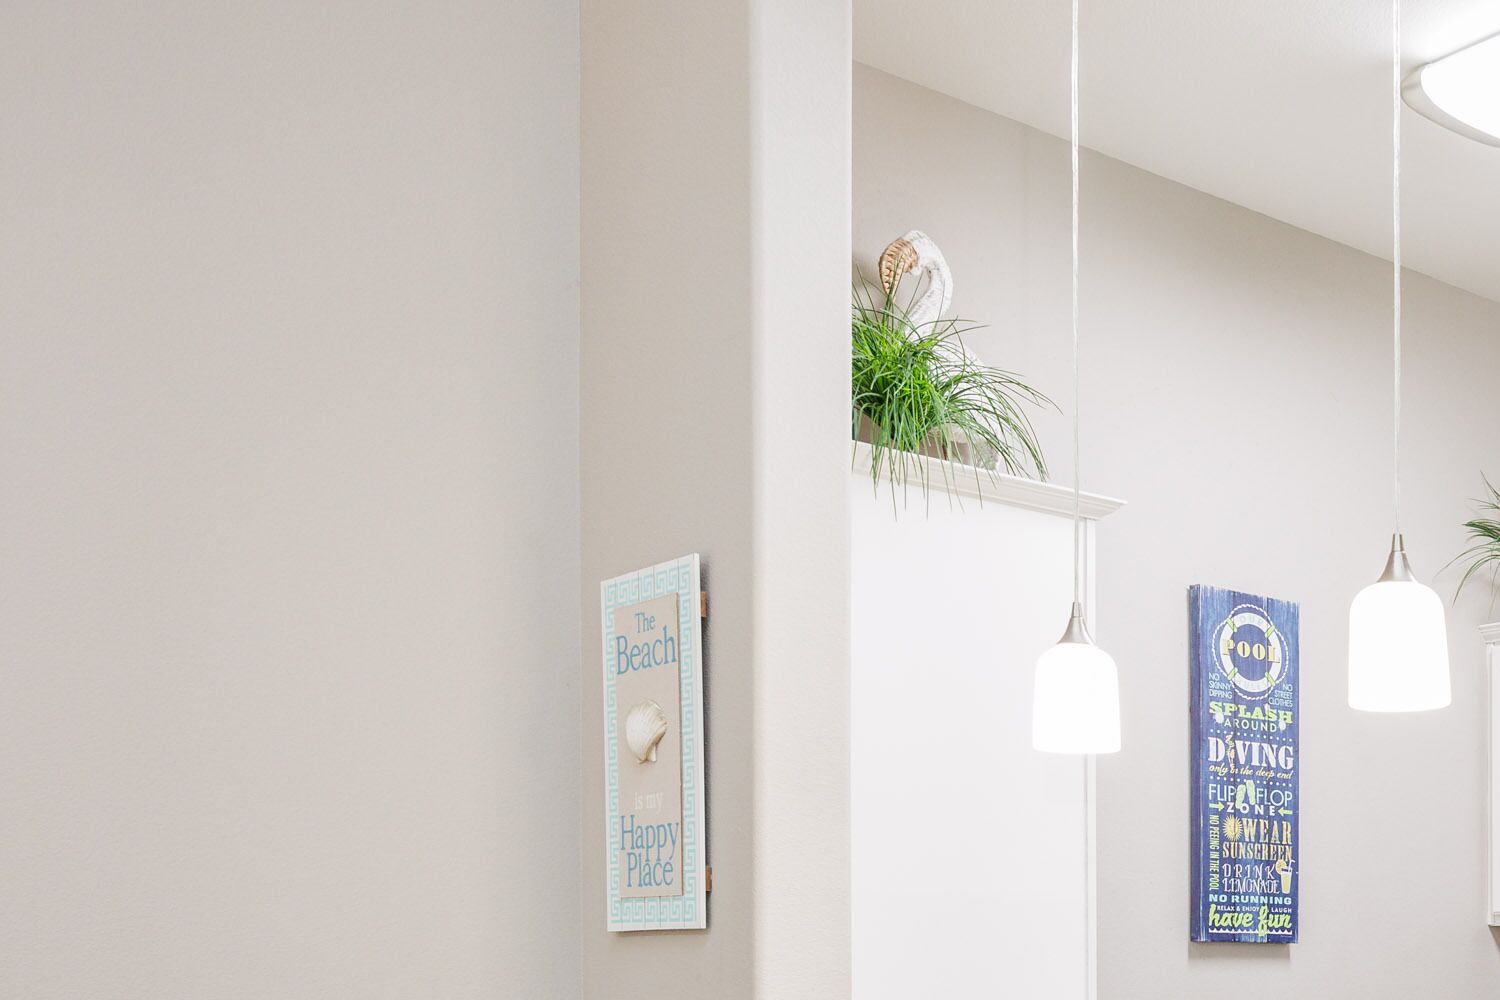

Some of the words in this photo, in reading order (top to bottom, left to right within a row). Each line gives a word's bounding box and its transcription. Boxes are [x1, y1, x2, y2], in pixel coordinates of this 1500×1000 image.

[634, 611, 656, 633] The
[616, 624, 677, 675] Beach
[1221, 638, 1281, 664] POOL
[1208, 672, 1220, 681] NO
[1208, 681, 1232, 690] SKINNY
[1282, 684, 1293, 692] NO
[1208, 701, 1294, 724] SPLASH
[1223, 718, 1277, 733] AROUND
[1207, 736, 1294, 770] DIVING
[1208, 762, 1228, 776] only
[1240, 765, 1254, 775] the
[1255, 766, 1275, 780] deep
[1277, 770, 1294, 779] end
[634, 791, 643, 809] is
[646, 792, 664, 814] my
[1208, 784, 1236, 802] FLIP
[1256, 788, 1294, 807] FLOP
[1227, 802, 1276, 816] ZONE
[1209, 815, 1220, 825] NO
[620, 814, 679, 862] Happy
[1209, 826, 1220, 849] PEEING
[1241, 817, 1293, 845] WEAR
[1209, 851, 1220, 859] IN
[1222, 841, 1293, 862] SUNSCREEN
[627, 852, 674, 887] Place
[1209, 859, 1220, 873] THE
[1222, 863, 1276, 880] DRINK
[1209, 873, 1220, 891] POOL
[1222, 876, 1280, 895] LEMONADE
[1208, 893, 1228, 903] NO
[1231, 894, 1292, 905] RUNNING
[1208, 903, 1254, 928] have
[1257, 904, 1293, 937] fun
